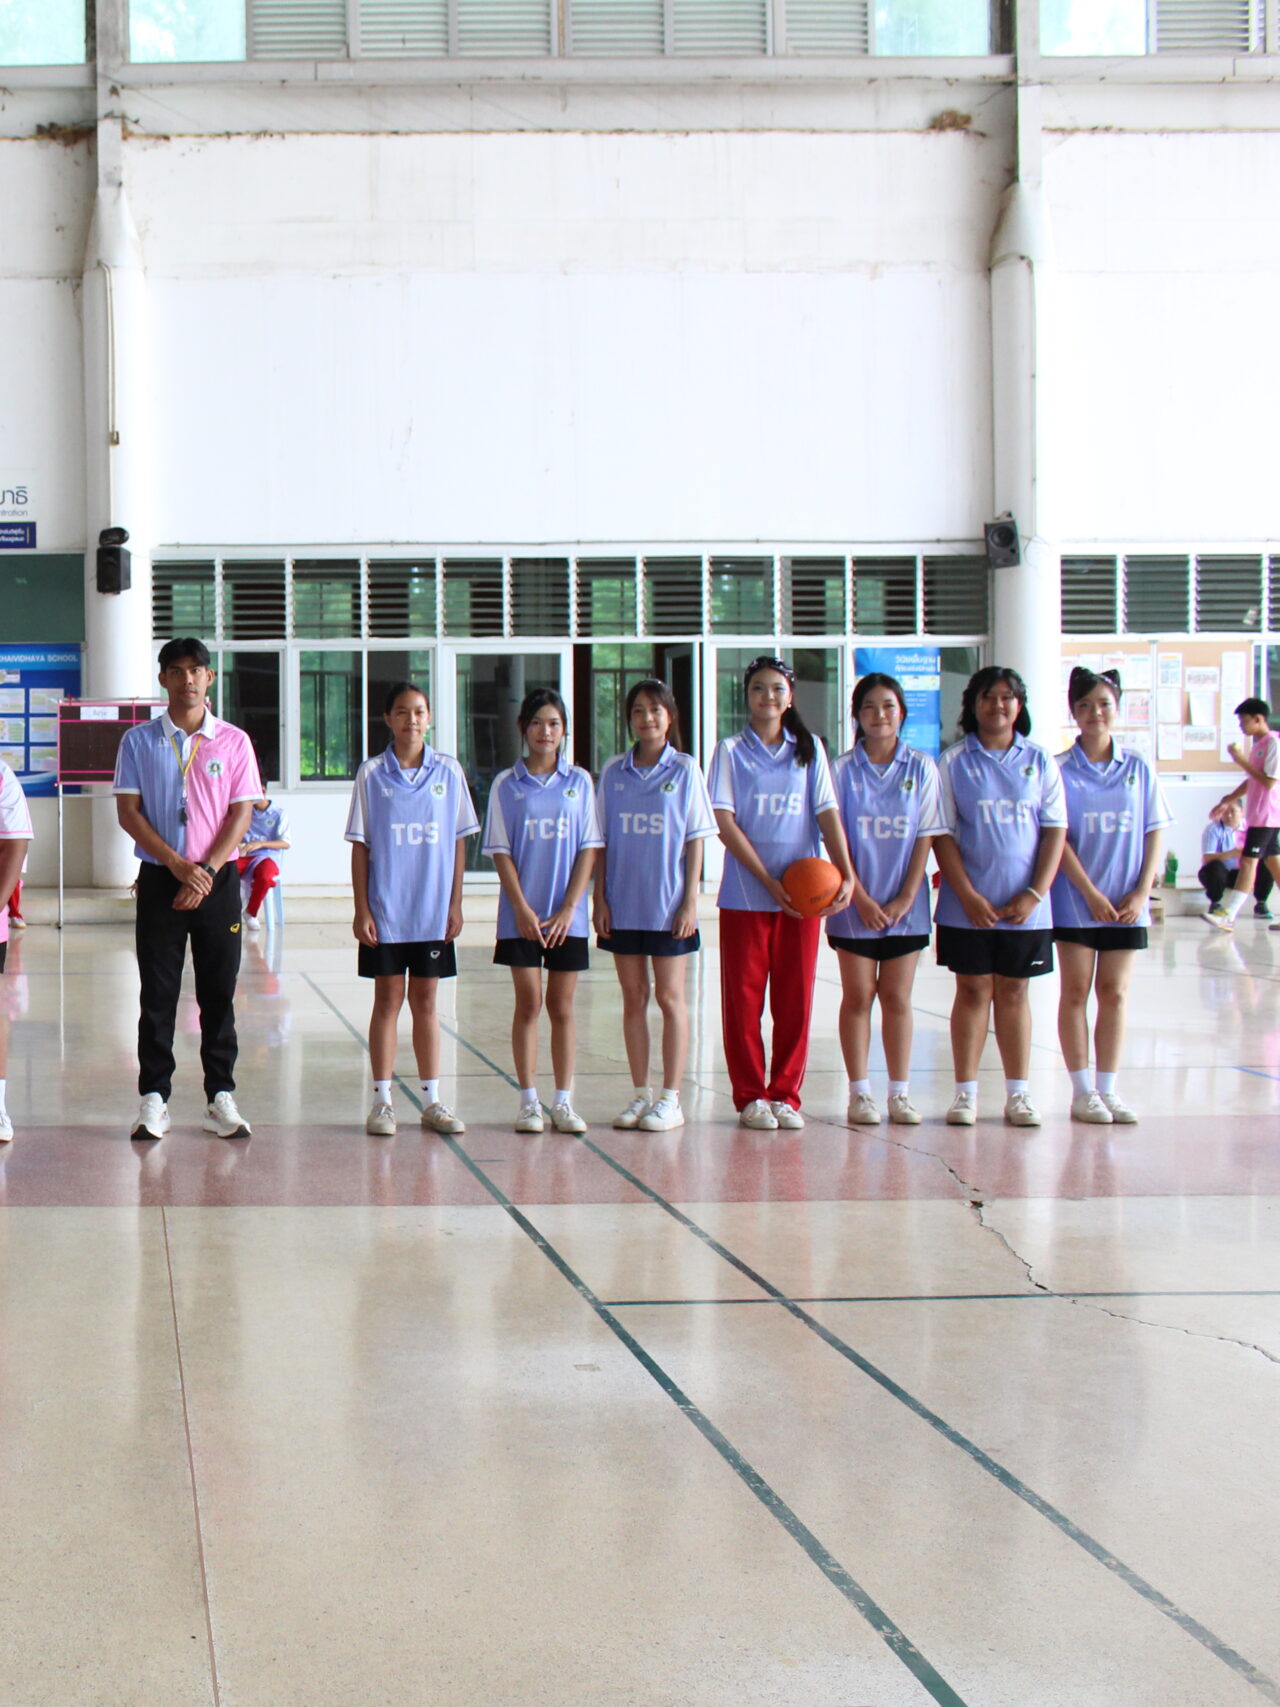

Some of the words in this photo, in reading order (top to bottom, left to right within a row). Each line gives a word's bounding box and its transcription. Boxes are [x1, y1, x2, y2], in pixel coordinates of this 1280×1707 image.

[47, 654, 79, 662] SCHOOL
[754, 793, 802, 816] TCS
[977, 800, 1032, 824] TCS
[524, 817, 569, 840] TCS
[619, 812, 664, 834] TCS
[857, 816, 910, 839] TCS
[1084, 811, 1133, 834] TCS
[391, 823, 439, 846] TCS
